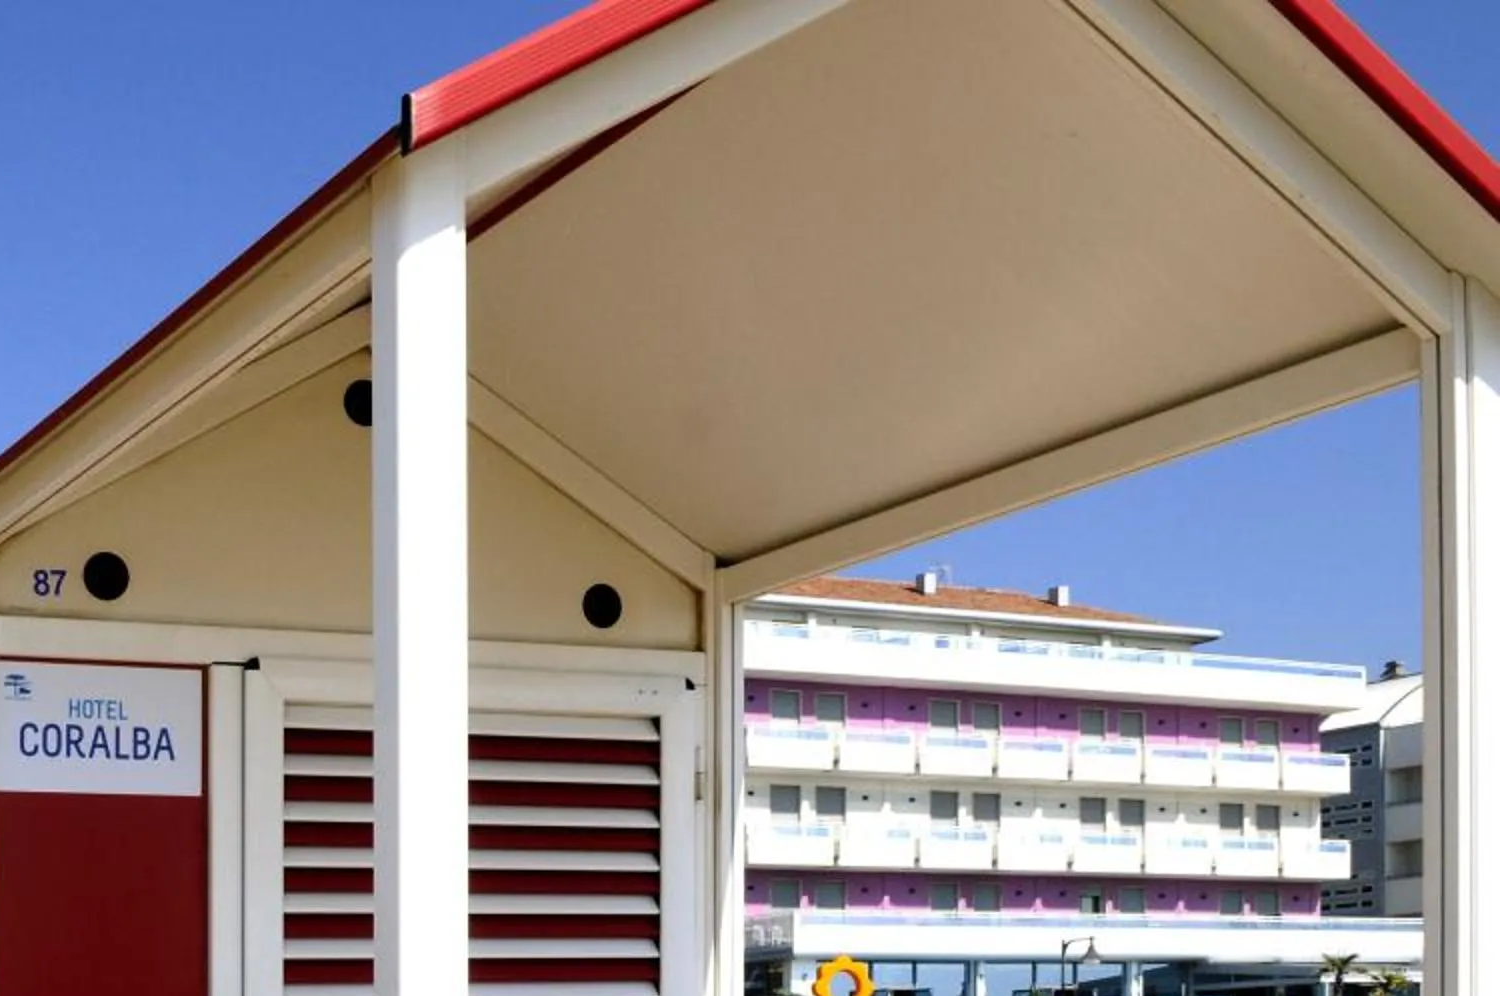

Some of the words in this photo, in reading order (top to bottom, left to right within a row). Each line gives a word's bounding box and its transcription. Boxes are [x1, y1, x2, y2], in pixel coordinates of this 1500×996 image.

[33, 569, 67, 596] 87
[67, 698, 128, 721] HOTEL
[19, 722, 176, 761] CORALBA
